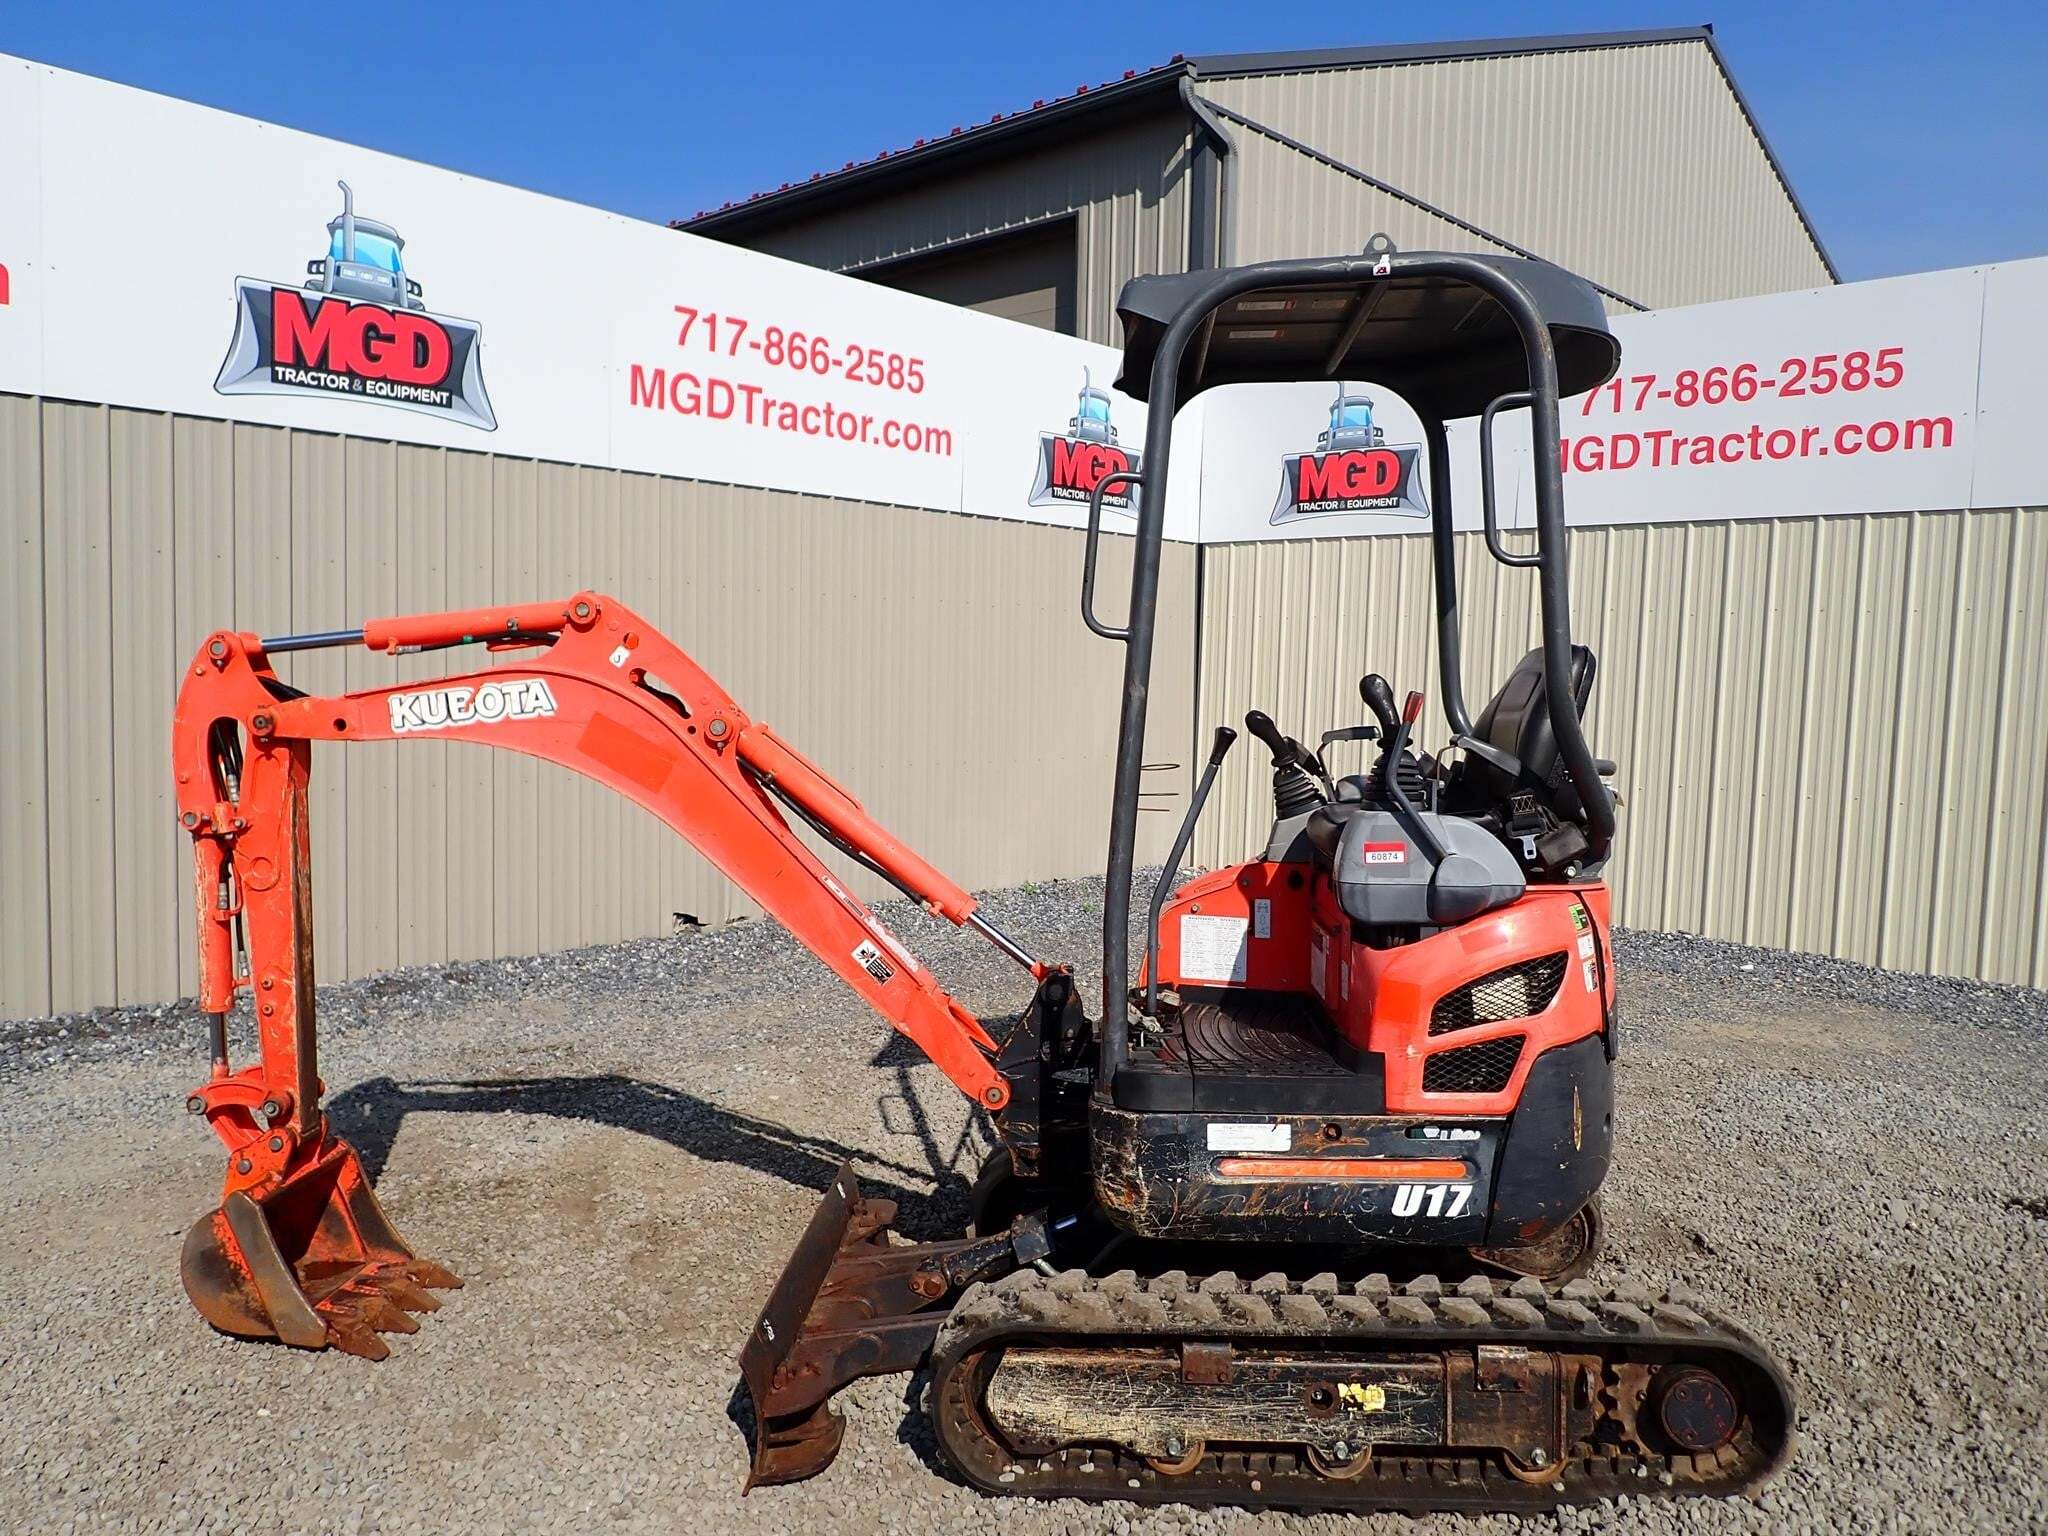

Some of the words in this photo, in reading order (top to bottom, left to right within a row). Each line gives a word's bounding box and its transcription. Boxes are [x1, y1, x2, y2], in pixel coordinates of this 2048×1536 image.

[273, 289, 452, 386] MGD
[674, 304, 925, 394] 717-866-2585
[275, 366, 350, 391] TRACTOR
[352, 378, 363, 392] &
[366, 380, 450, 405] EQUIPMENT
[629, 363, 952, 456] MGDTractor.com
[1053, 437, 1129, 495] MGD
[1561, 415, 1953, 474] GDTractor.com
[1053, 486, 1085, 500] TRACTOR
[1300, 450, 1400, 500] MGD
[1299, 501, 1338, 511] TRACTOR
[1347, 497, 1399, 509] EQUIPMENT
[391, 680, 556, 730] KUBOTA
[1371, 853, 1398, 861] 60874
[1391, 1185, 1474, 1218] U17
